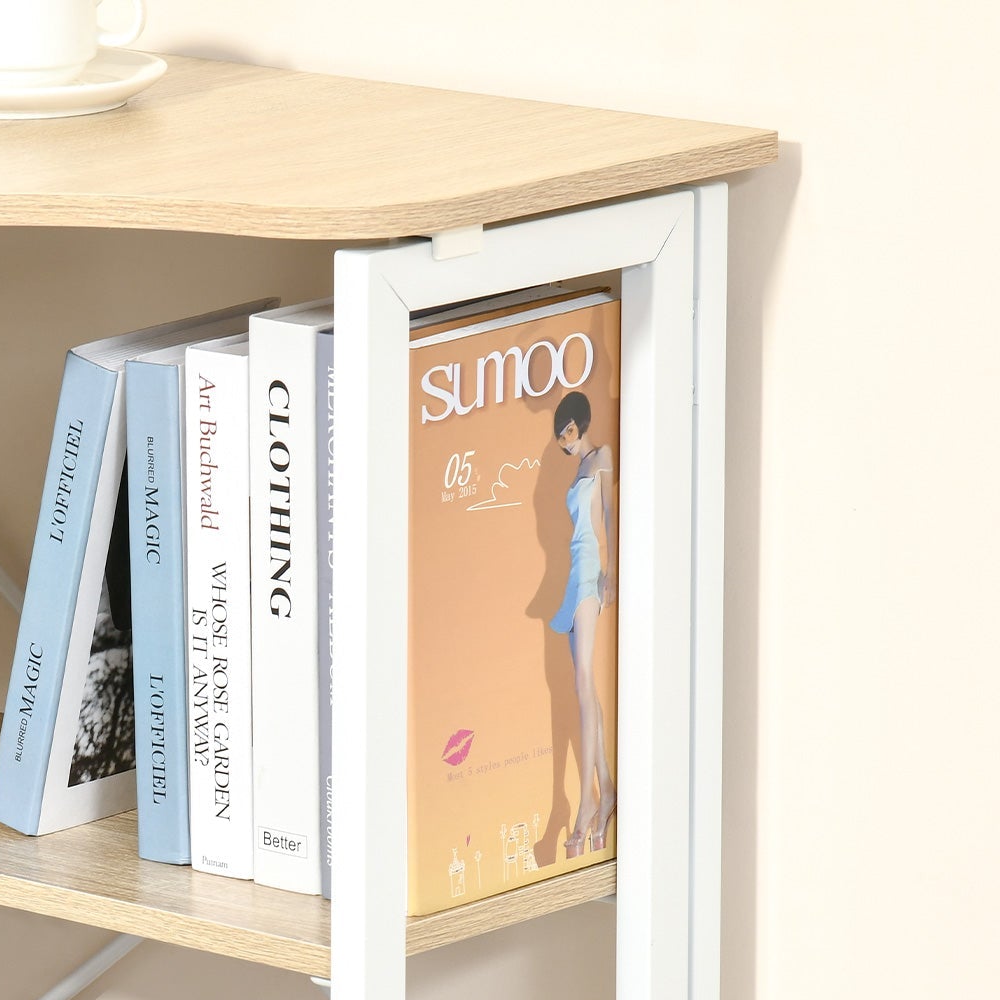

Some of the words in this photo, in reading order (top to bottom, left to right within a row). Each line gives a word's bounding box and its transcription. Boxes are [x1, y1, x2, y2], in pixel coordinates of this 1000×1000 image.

[198, 373, 216, 412] Art
[49, 418, 84, 544] L'OFFICIEL
[146, 436, 155, 483] BLURRED
[200, 420, 220, 530] Buchwald
[441, 491, 455, 503] May
[458, 483, 478, 499] 2015
[444, 450, 476, 489] 05
[144, 485, 161, 565] MAGIC
[268, 379, 291, 619] CLOTHING
[192, 607, 208, 627] IS
[211, 561, 228, 648] WHOSE
[19, 642, 44, 719] MAGIC
[192, 635, 208, 660] IT
[193, 664, 210, 767] ANYWAY?
[212, 655, 229, 714] ROSE
[14, 718, 28, 763] BLURRED
[149, 673, 167, 805] L'OFFICIEL
[213, 722, 231, 822] GARDEN
[262, 831, 302, 853] Better
